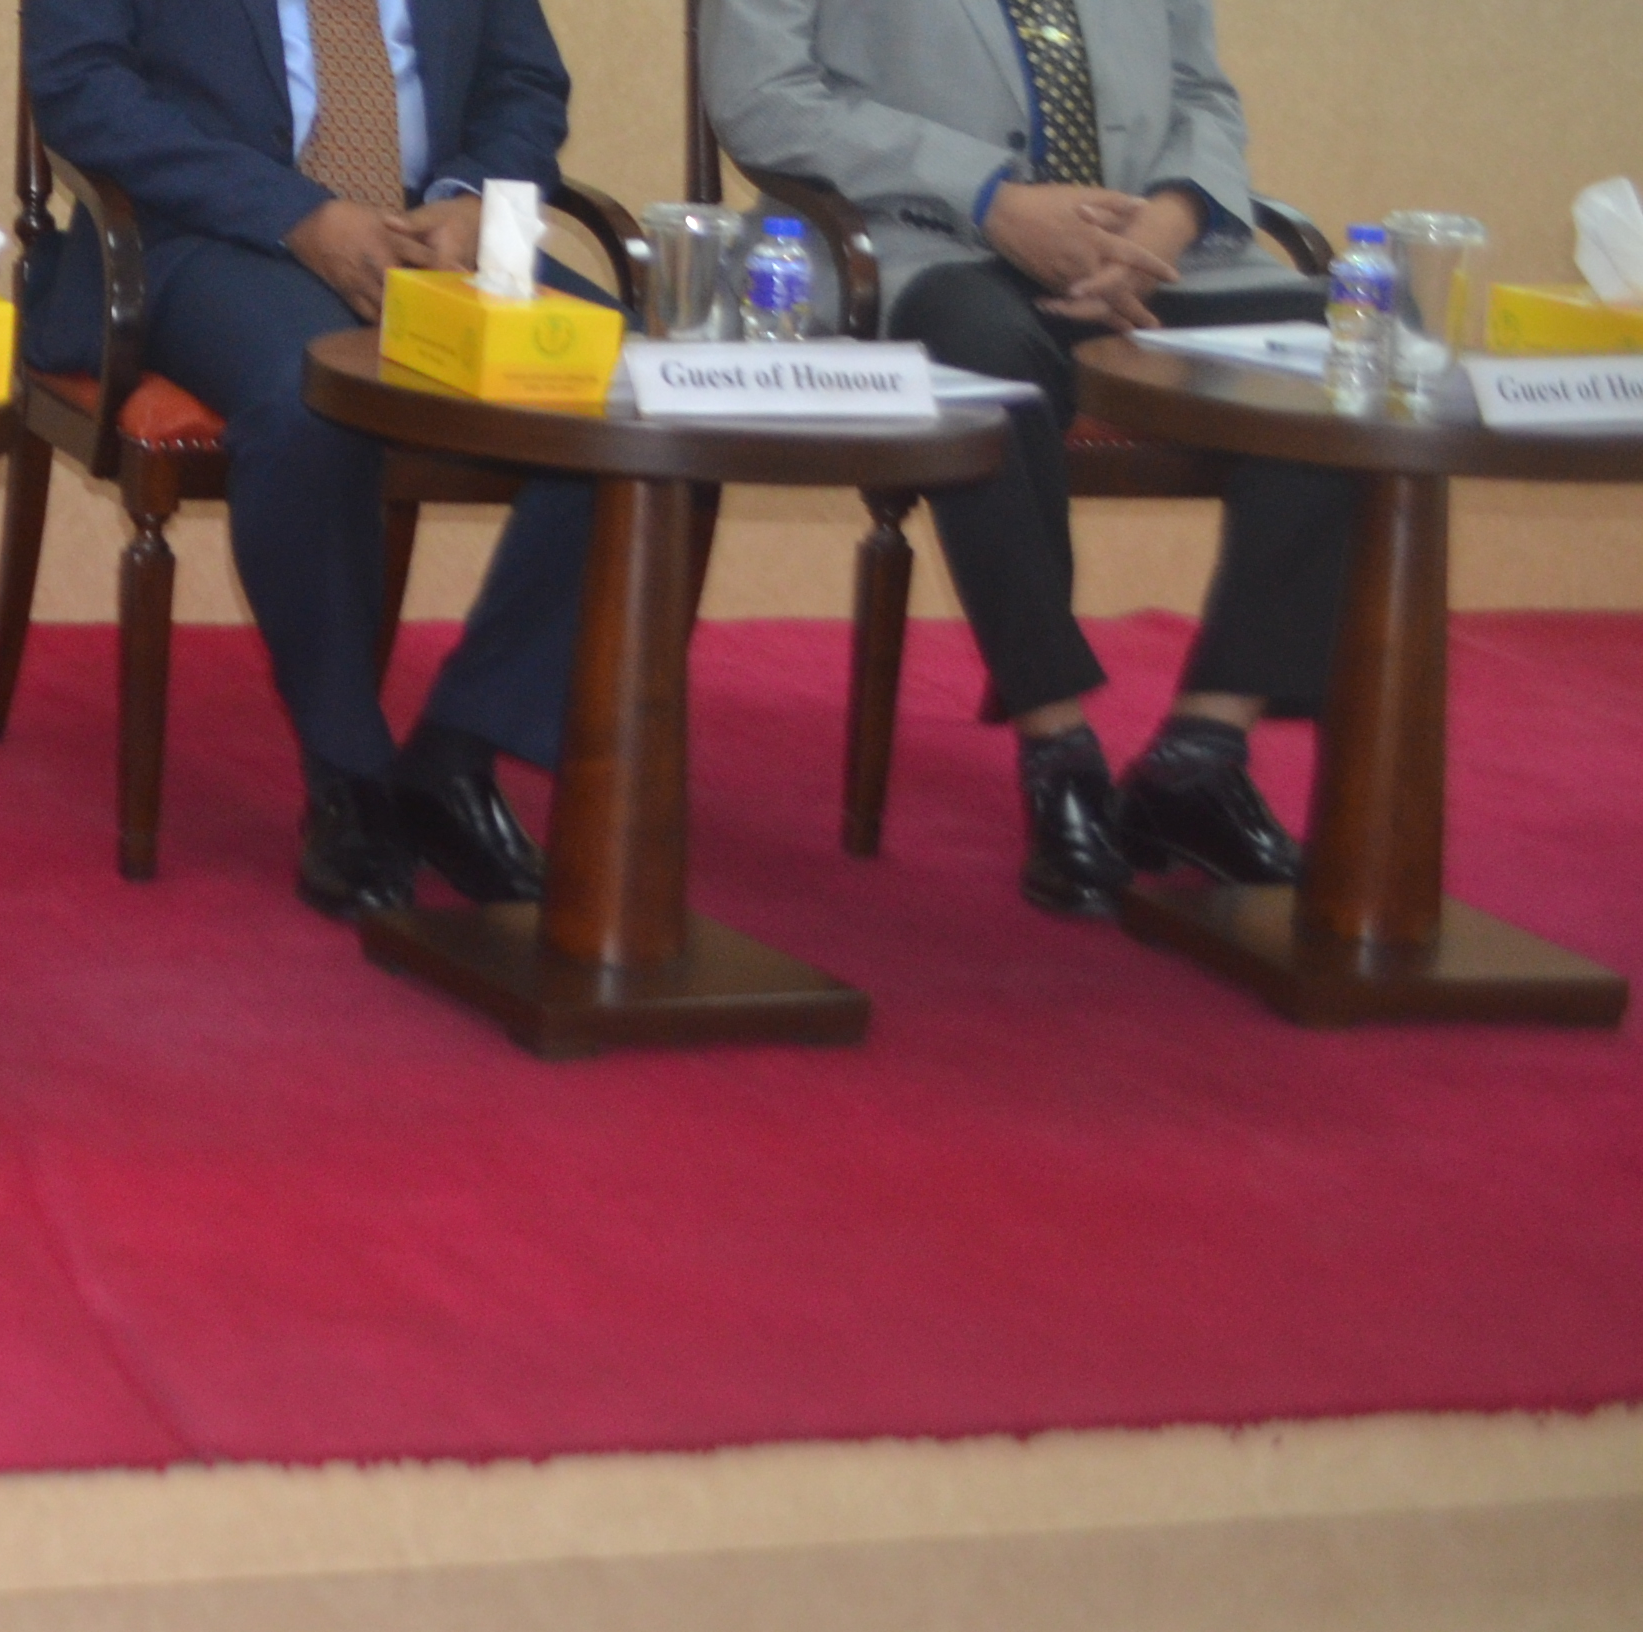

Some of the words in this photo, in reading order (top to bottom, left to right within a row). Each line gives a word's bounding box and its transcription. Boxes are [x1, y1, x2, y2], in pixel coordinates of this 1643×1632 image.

[660, 360, 747, 391] Guest
[755, 362, 786, 391] of
[794, 364, 902, 394] Honour
